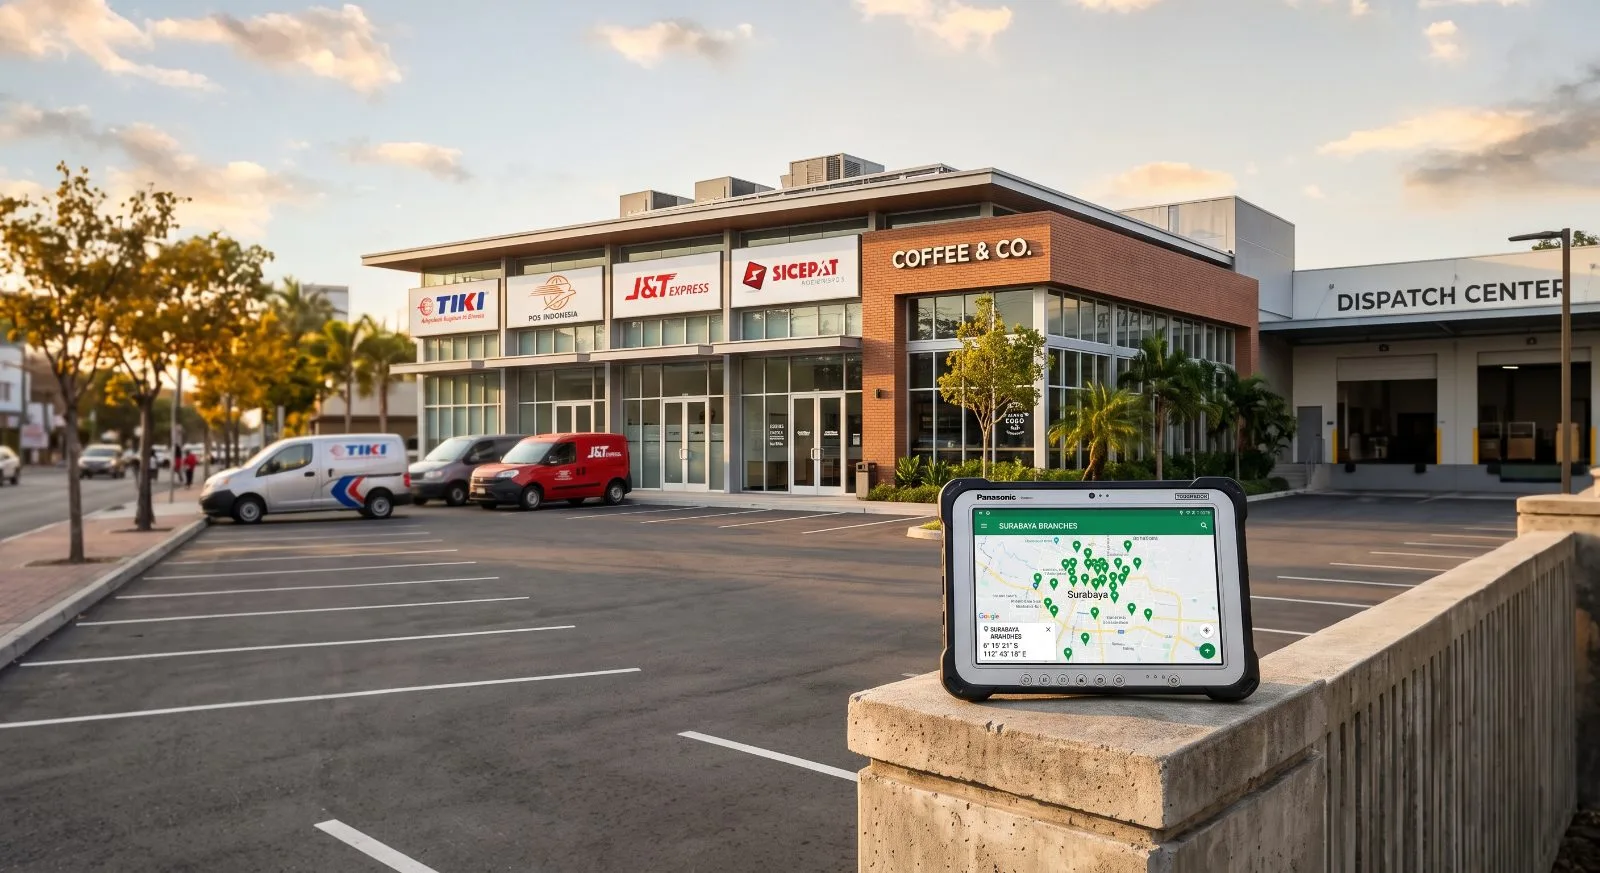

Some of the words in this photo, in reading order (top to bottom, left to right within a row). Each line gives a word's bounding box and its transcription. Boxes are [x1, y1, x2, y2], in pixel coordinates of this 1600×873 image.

[892, 243, 970, 269] COFFEE
[975, 241, 989, 260] &
[996, 237, 1032, 259] CO.
[772, 259, 838, 281] SICEPAT
[625, 273, 677, 301] J&T
[669, 283, 709, 296] EXPRESS
[436, 291, 485, 314] TIKI
[1337, 286, 1456, 312] DISPATCH
[528, 314, 541, 322] POS
[543, 311, 578, 320] INDONESIA
[587, 445, 609, 458] J&T
[999, 522, 1037, 530] SURABAYA
[1038, 522, 1078, 530] BRANCHES
[1067, 590, 1109, 601] Surabaya
